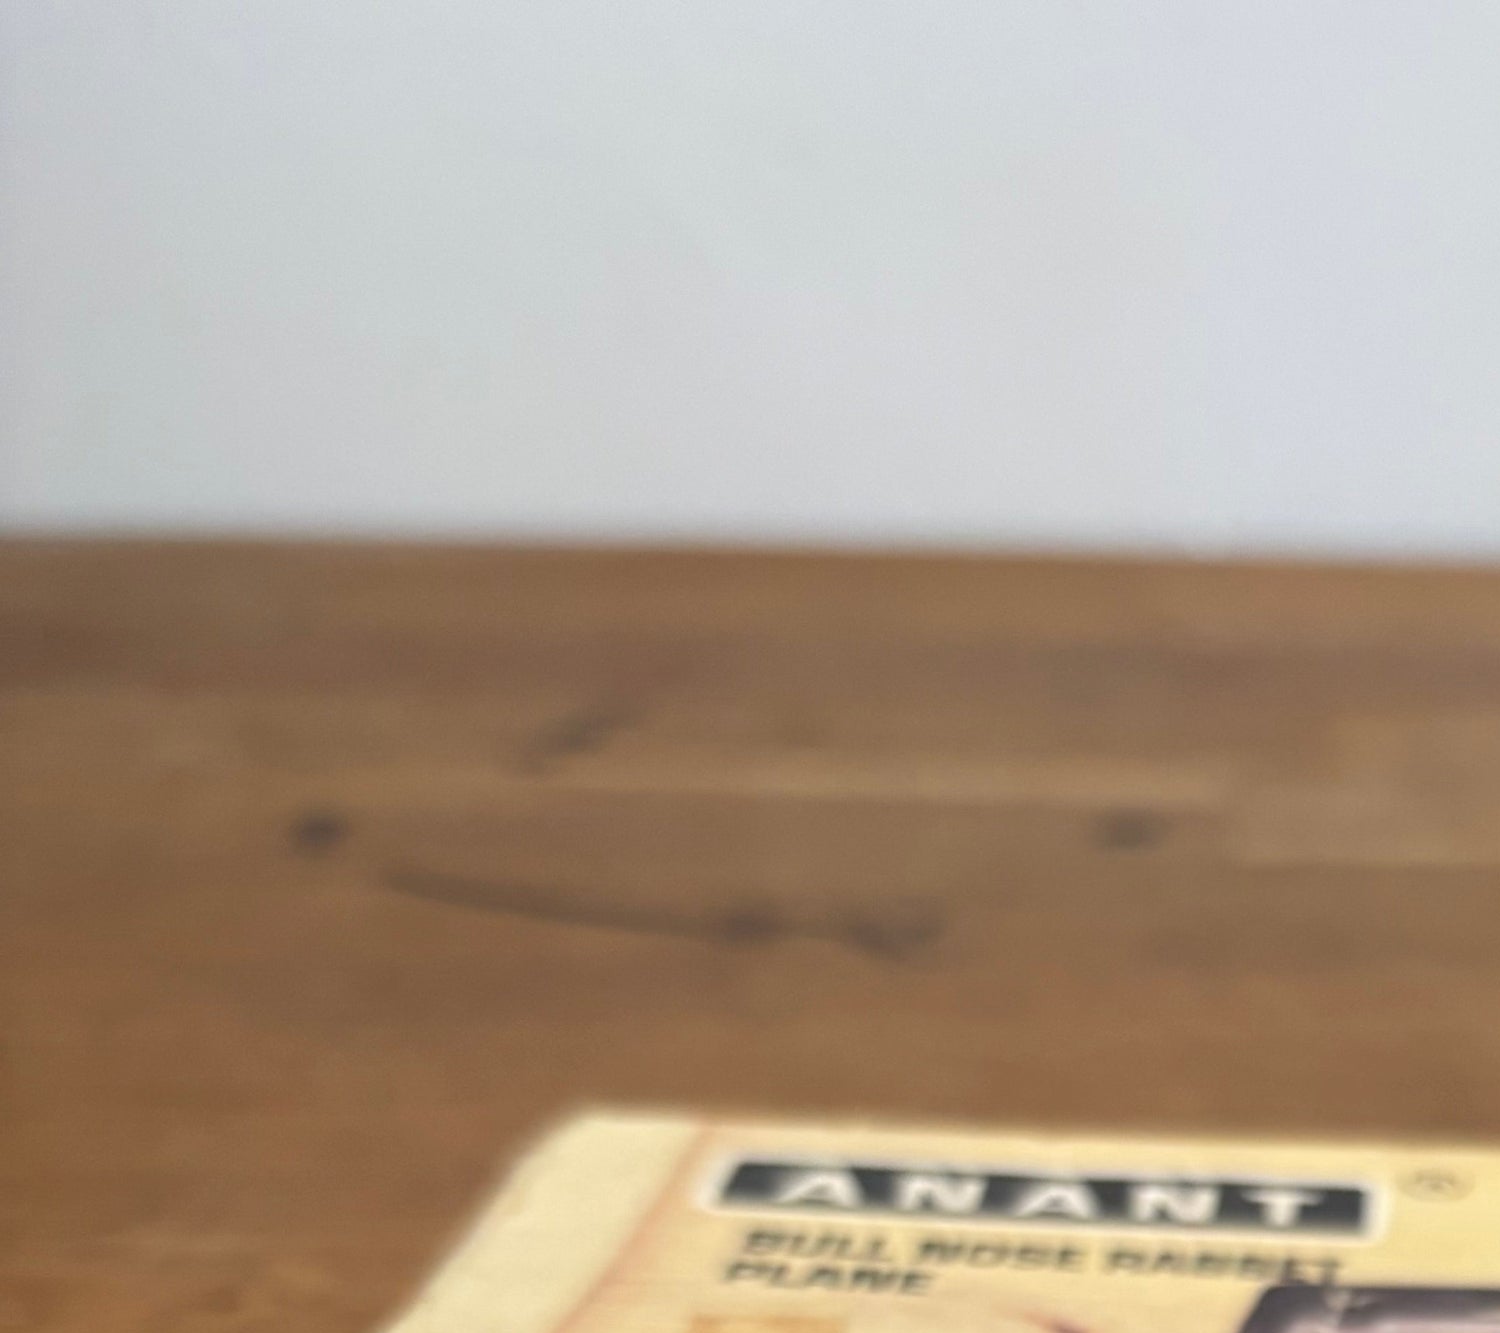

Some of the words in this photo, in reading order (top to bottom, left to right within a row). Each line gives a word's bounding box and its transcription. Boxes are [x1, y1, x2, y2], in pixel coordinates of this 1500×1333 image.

[775, 1169, 1326, 1230] ANANT
[741, 1229, 893, 1263] BULL
[919, 1237, 1088, 1273] NOSE
[724, 1260, 936, 1298] PLANE
